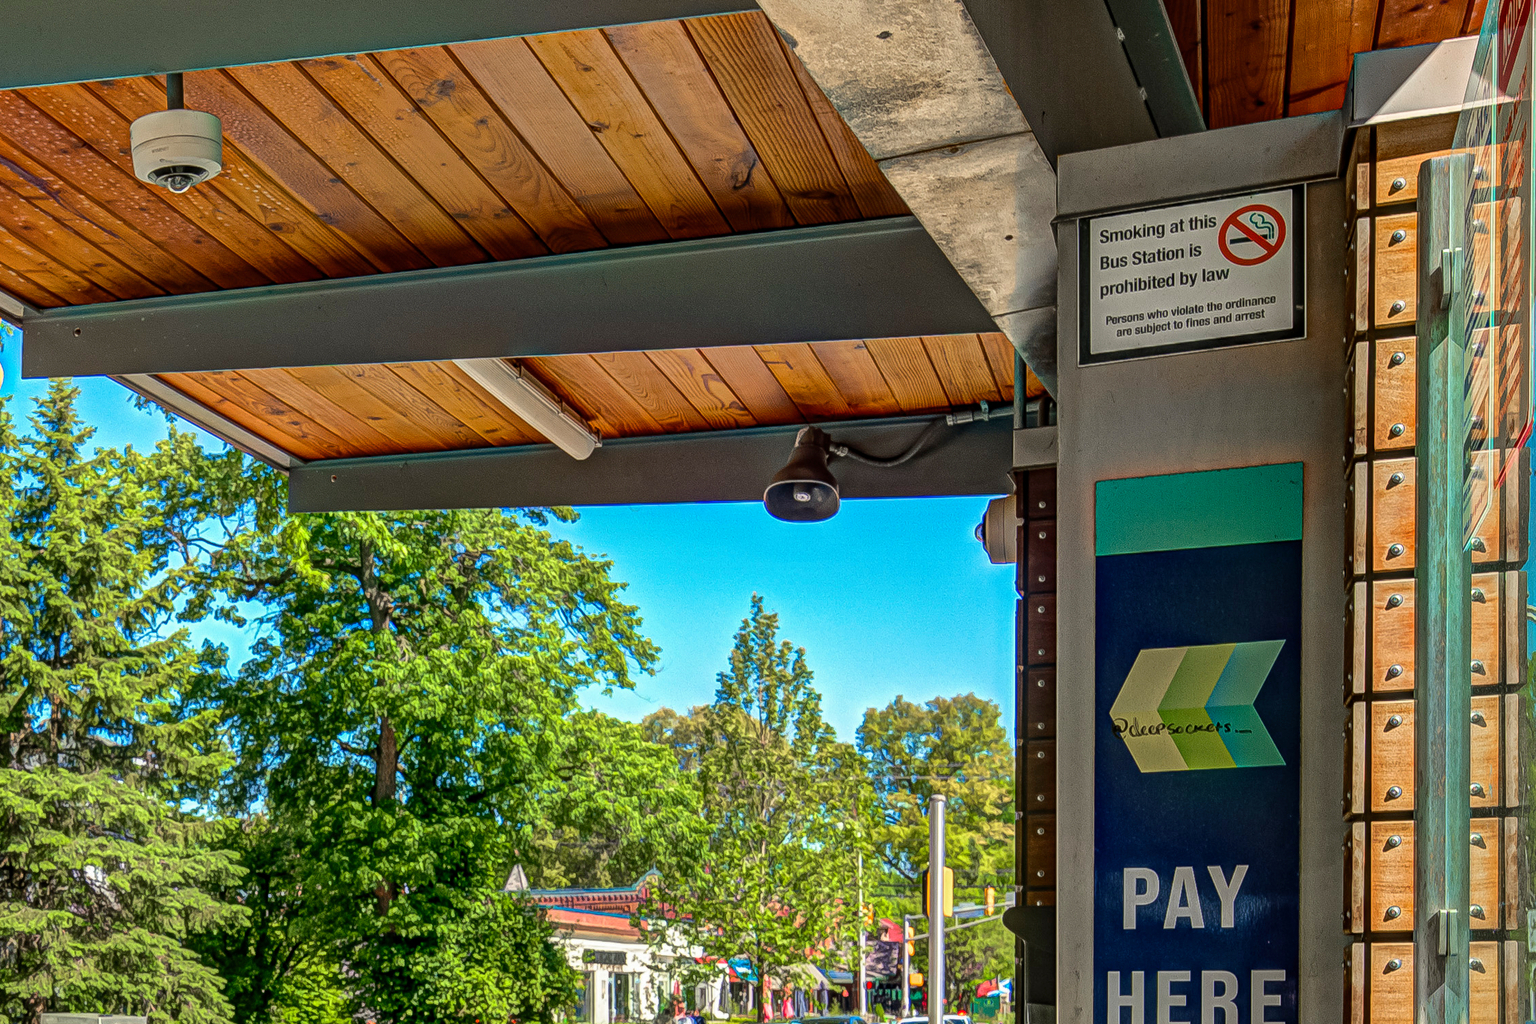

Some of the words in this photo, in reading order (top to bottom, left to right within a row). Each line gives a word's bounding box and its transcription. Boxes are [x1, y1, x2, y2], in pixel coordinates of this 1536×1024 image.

[1099, 224, 1165, 243] Smoking
[1170, 219, 1185, 234] at
[1188, 214, 1217, 231] this
[1100, 255, 1128, 270] Bus
[1132, 247, 1184, 265] Station
[1189, 243, 1202, 258] is
[1100, 272, 1175, 299] prohibited
[1180, 271, 1198, 287] by
[1202, 268, 1230, 282] law
[1105, 312, 1145, 325] Persons
[1147, 308, 1169, 320] who
[1171, 304, 1204, 317] violate
[1207, 301, 1223, 312] the
[1225, 295, 1276, 310] ordinance
[1116, 327, 1132, 338] are
[1135, 320, 1171, 335] subject
[1173, 319, 1183, 330] to
[1186, 316, 1211, 329] fines
[1213, 312, 1232, 325] and
[1235, 308, 1266, 322] arrest
[1123, 865, 1250, 930] PAY
